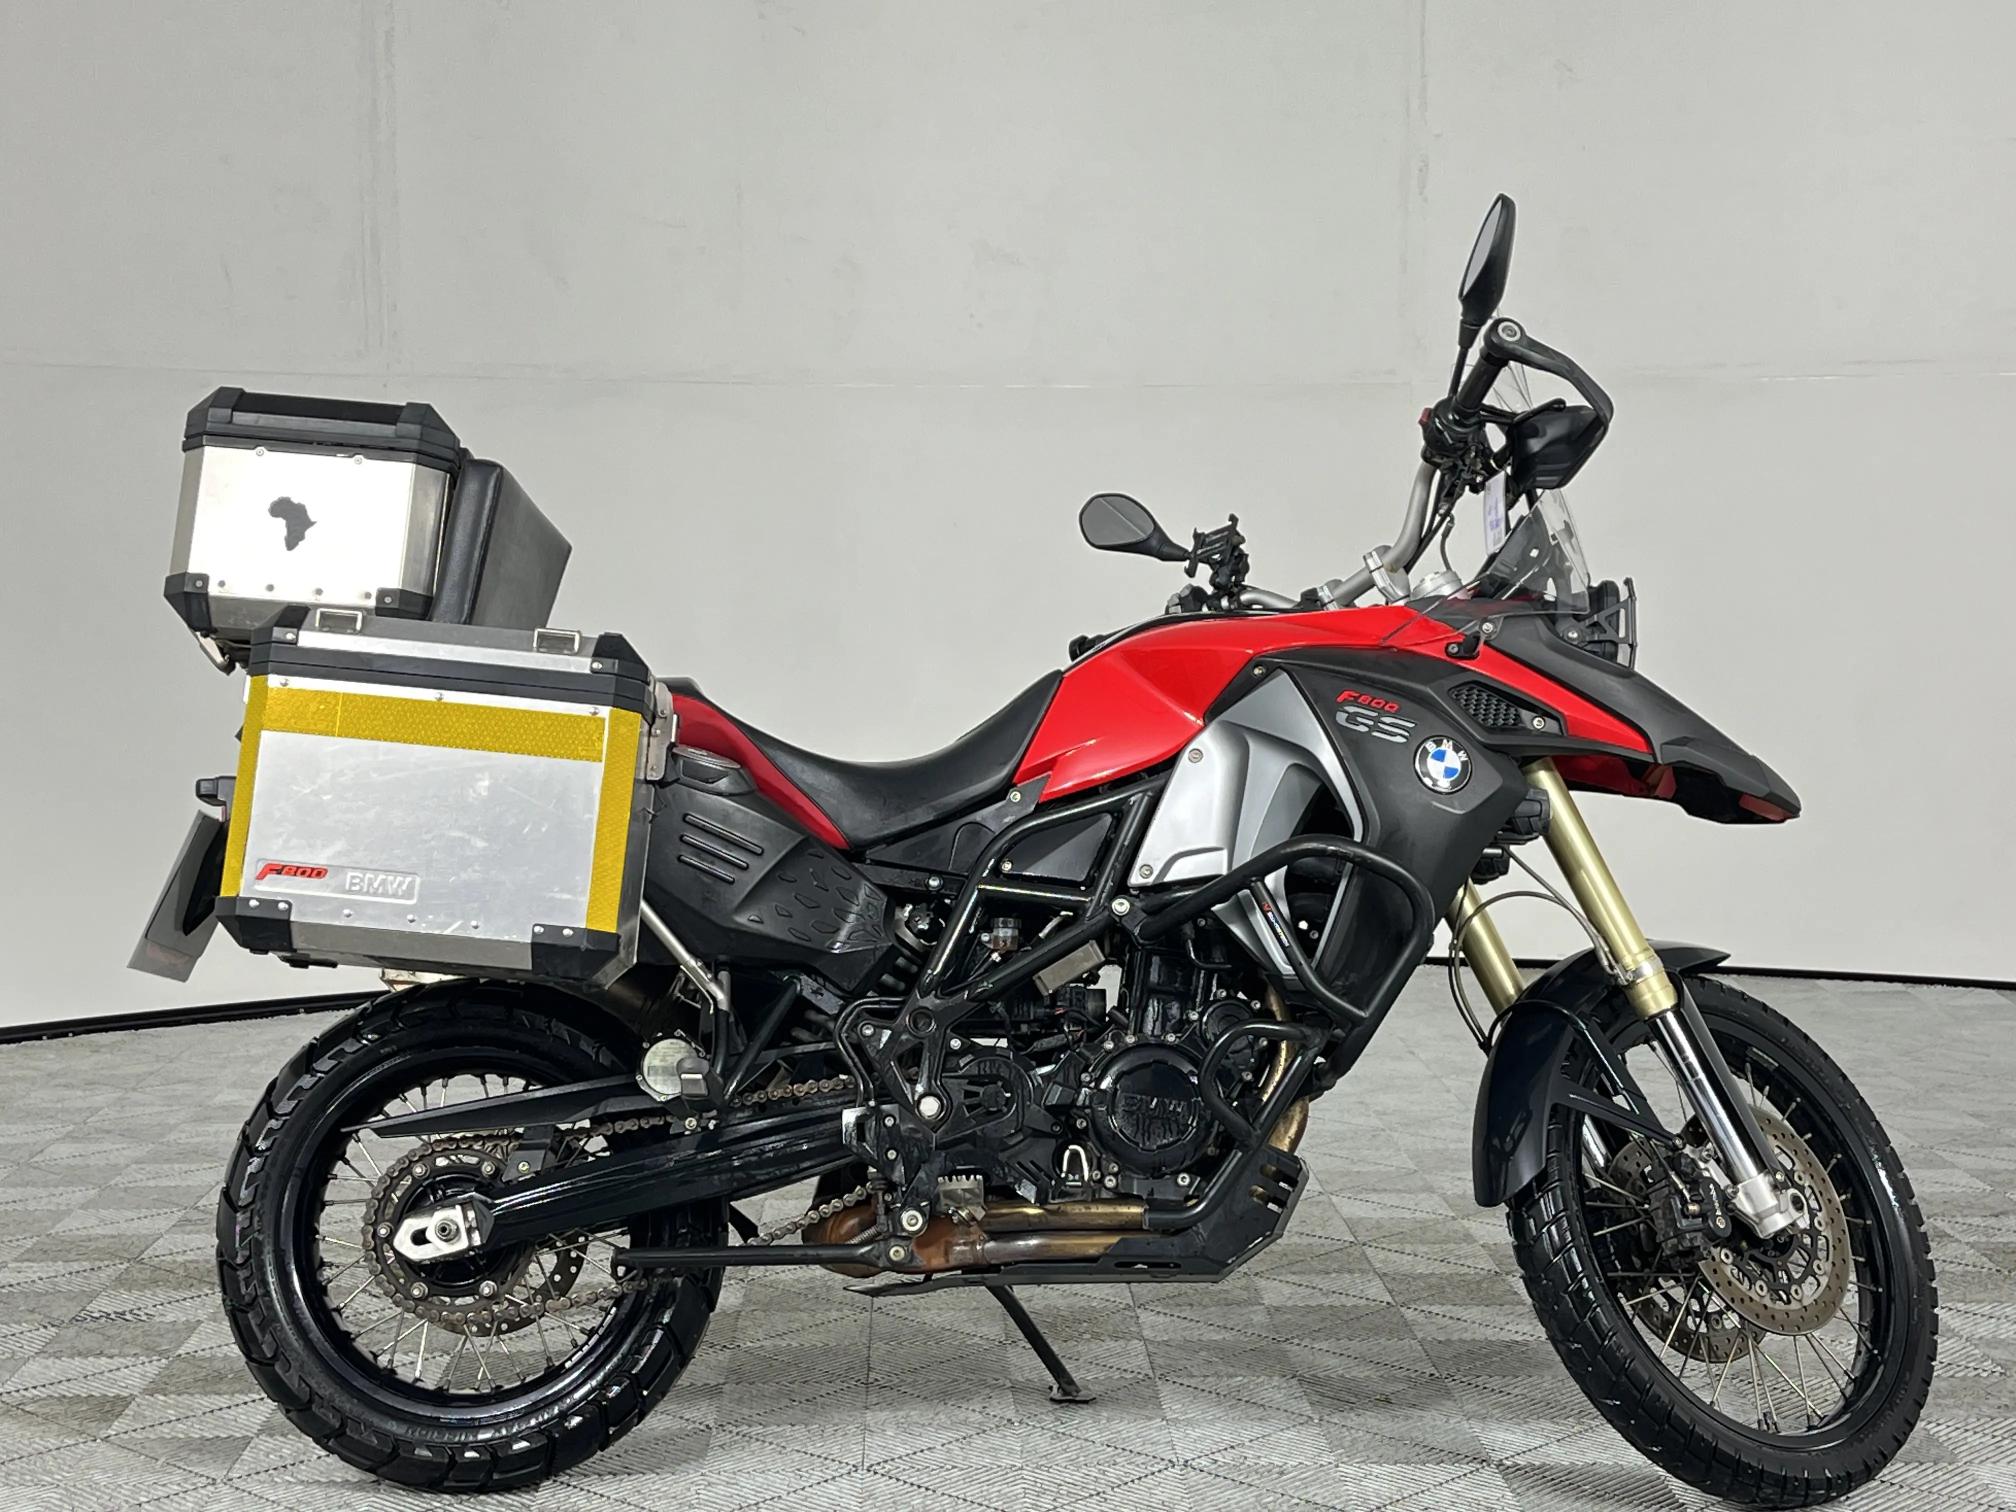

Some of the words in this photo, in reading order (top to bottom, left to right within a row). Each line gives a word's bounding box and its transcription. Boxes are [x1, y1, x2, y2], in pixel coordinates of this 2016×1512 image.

[1336, 690, 1400, 713] F800
[1336, 705, 1417, 743] GS
[1425, 739, 1469, 762] BMW
[255, 863, 329, 880] F800
[345, 872, 412, 895] BMW
